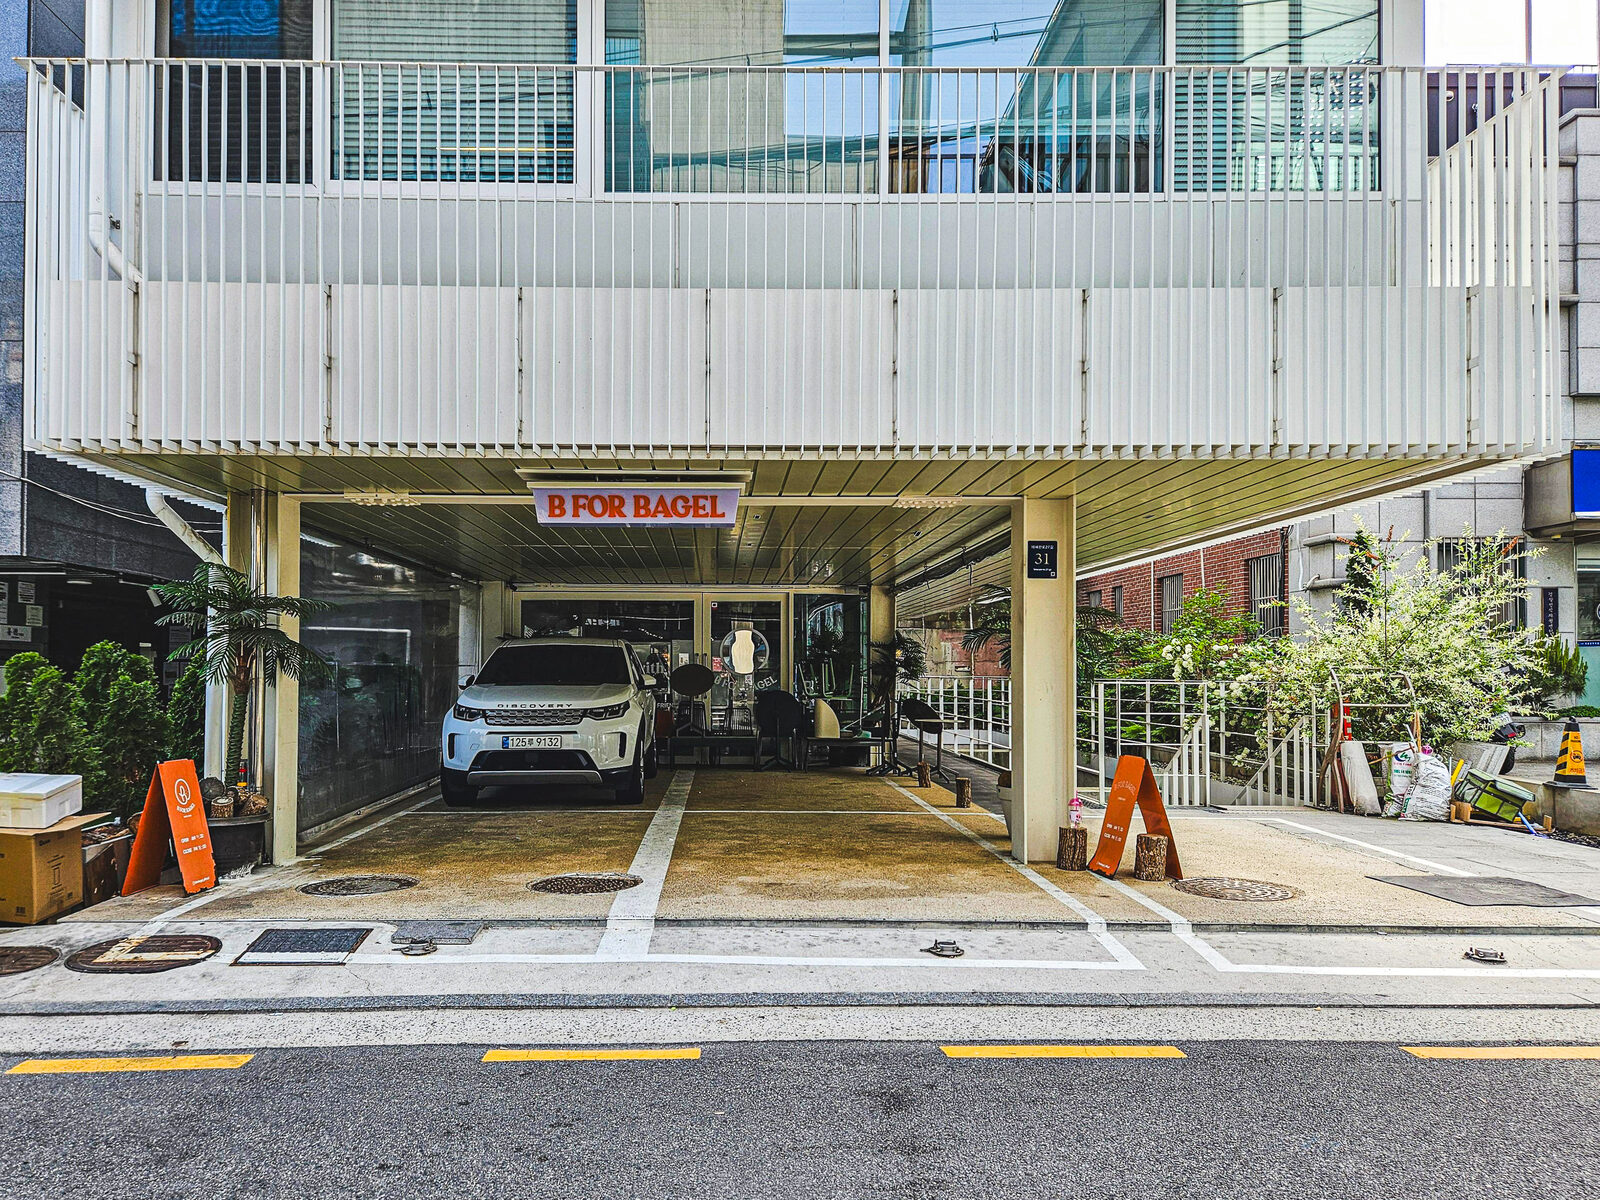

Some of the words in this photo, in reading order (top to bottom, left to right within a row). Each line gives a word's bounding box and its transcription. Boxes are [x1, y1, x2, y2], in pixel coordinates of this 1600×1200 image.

[548, 495, 566, 518] B
[572, 495, 626, 518] FOR
[633, 495, 725, 518] BAGEL
[1034, 553, 1050, 565] 31
[643, 662, 665, 674] ith
[536, 737, 559, 747] 9132
